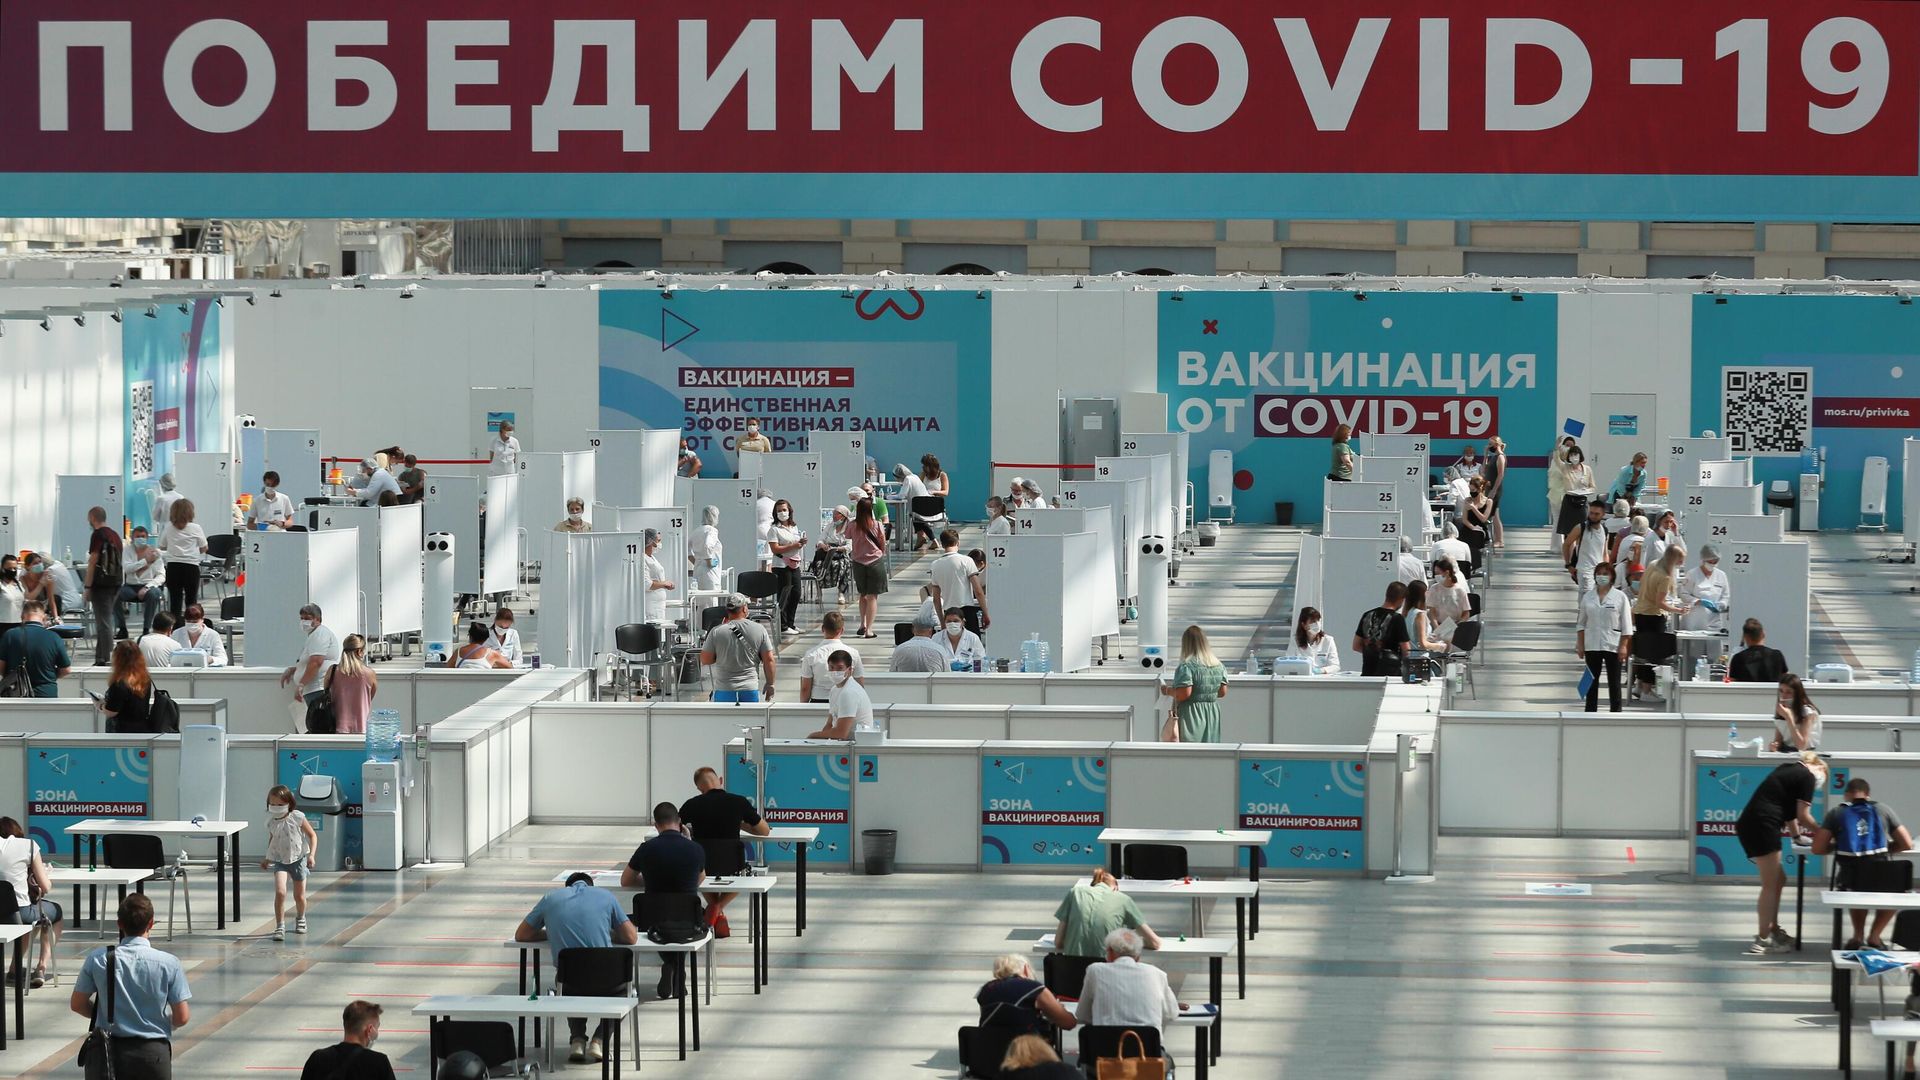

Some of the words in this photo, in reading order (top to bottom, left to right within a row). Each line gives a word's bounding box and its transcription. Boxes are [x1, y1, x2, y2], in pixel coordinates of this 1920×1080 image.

[38, 18, 924, 152] ПОБЕДИМ
[1010, 15, 1890, 135] COVID-19
[1177, 351, 1536, 395] ВАКЦИНАЦИЯ
[684, 370, 830, 387] ВАКЦИНАЦИЯ
[684, 397, 850, 414] ЕДИНСТВЕННАЯ
[1177, 398, 1245, 433] ОТ
[1259, 398, 1492, 436] COVID-19
[1824, 406, 1910, 418] mos.ru/privivka
[849, 416, 941, 433] ЗАЩИТА
[308, 439, 315, 447] 9
[590, 439, 601, 447] 10
[851, 440, 861, 449] 19
[1124, 441, 1137, 450] 20
[1414, 443, 1426, 451] 29
[1671, 446, 1684, 455] 30
[220, 462, 226, 470] 7
[806, 462, 817, 471] 17
[1098, 466, 1109, 476] 18
[1406, 467, 1419, 476] 27
[109, 485, 116, 495] 5
[430, 485, 436, 495] 6
[741, 489, 752, 498] 15
[1064, 491, 1077, 500] 16
[1379, 492, 1392, 502] 25
[1688, 496, 1703, 505] 26
[324, 517, 332, 527] 4
[670, 518, 683, 528] 13
[1019, 519, 1033, 529] 14
[1381, 523, 1396, 533] 23
[1712, 526, 1728, 536] 24
[253, 543, 260, 553] 2
[626, 544, 637, 554] 11
[992, 547, 1006, 558] 12
[1380, 551, 1393, 562] 21
[1734, 553, 1750, 564] 22
[862, 761, 875, 776] 2
[1833, 773, 1845, 789] 3
[35, 790, 78, 801] ЗОНА
[34, 804, 143, 815] ВАКЦИНИРОВАНИЯ
[989, 798, 1033, 811] ЗОНА
[1247, 802, 1291, 814] ЗОНА
[988, 813, 1101, 824] ВАКЦИНИРОВАНИЯ
[1703, 809, 1742, 821] ЗОН
[1246, 816, 1358, 828] ВАКЦИНИРОВАНИЯ
